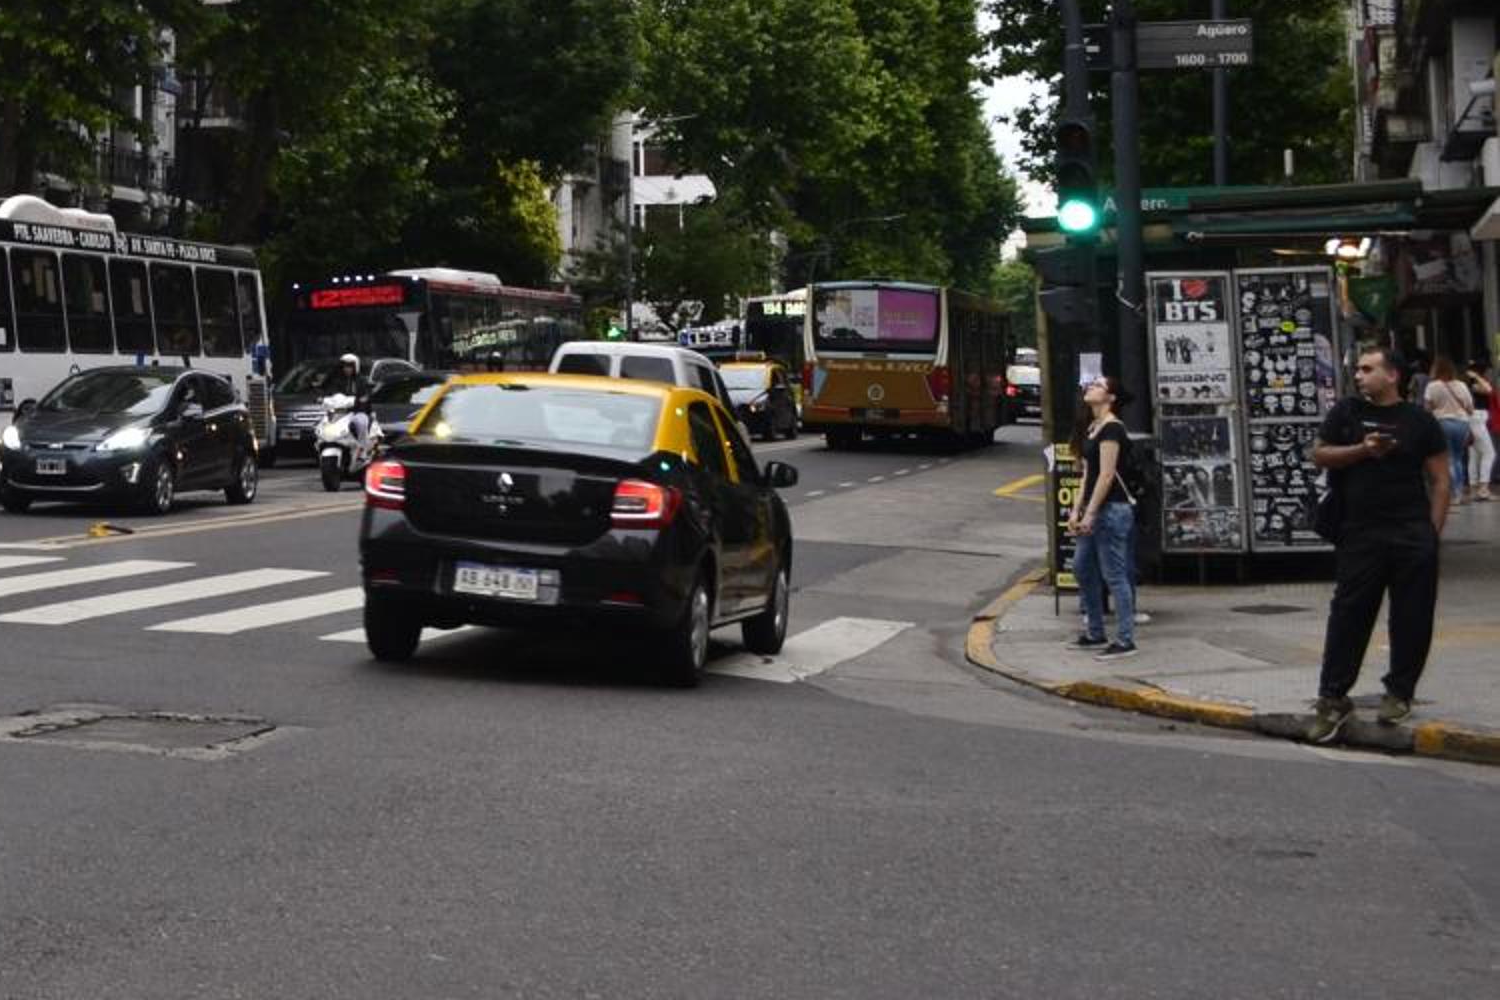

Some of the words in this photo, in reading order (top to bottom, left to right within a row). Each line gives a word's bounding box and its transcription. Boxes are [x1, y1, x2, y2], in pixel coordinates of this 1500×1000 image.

[1197, 24, 1248, 38] Agüero
[1175, 54, 1205, 66] 1600
[1219, 53, 1248, 65] 1700
[1165, 301, 1217, 321] BTS
